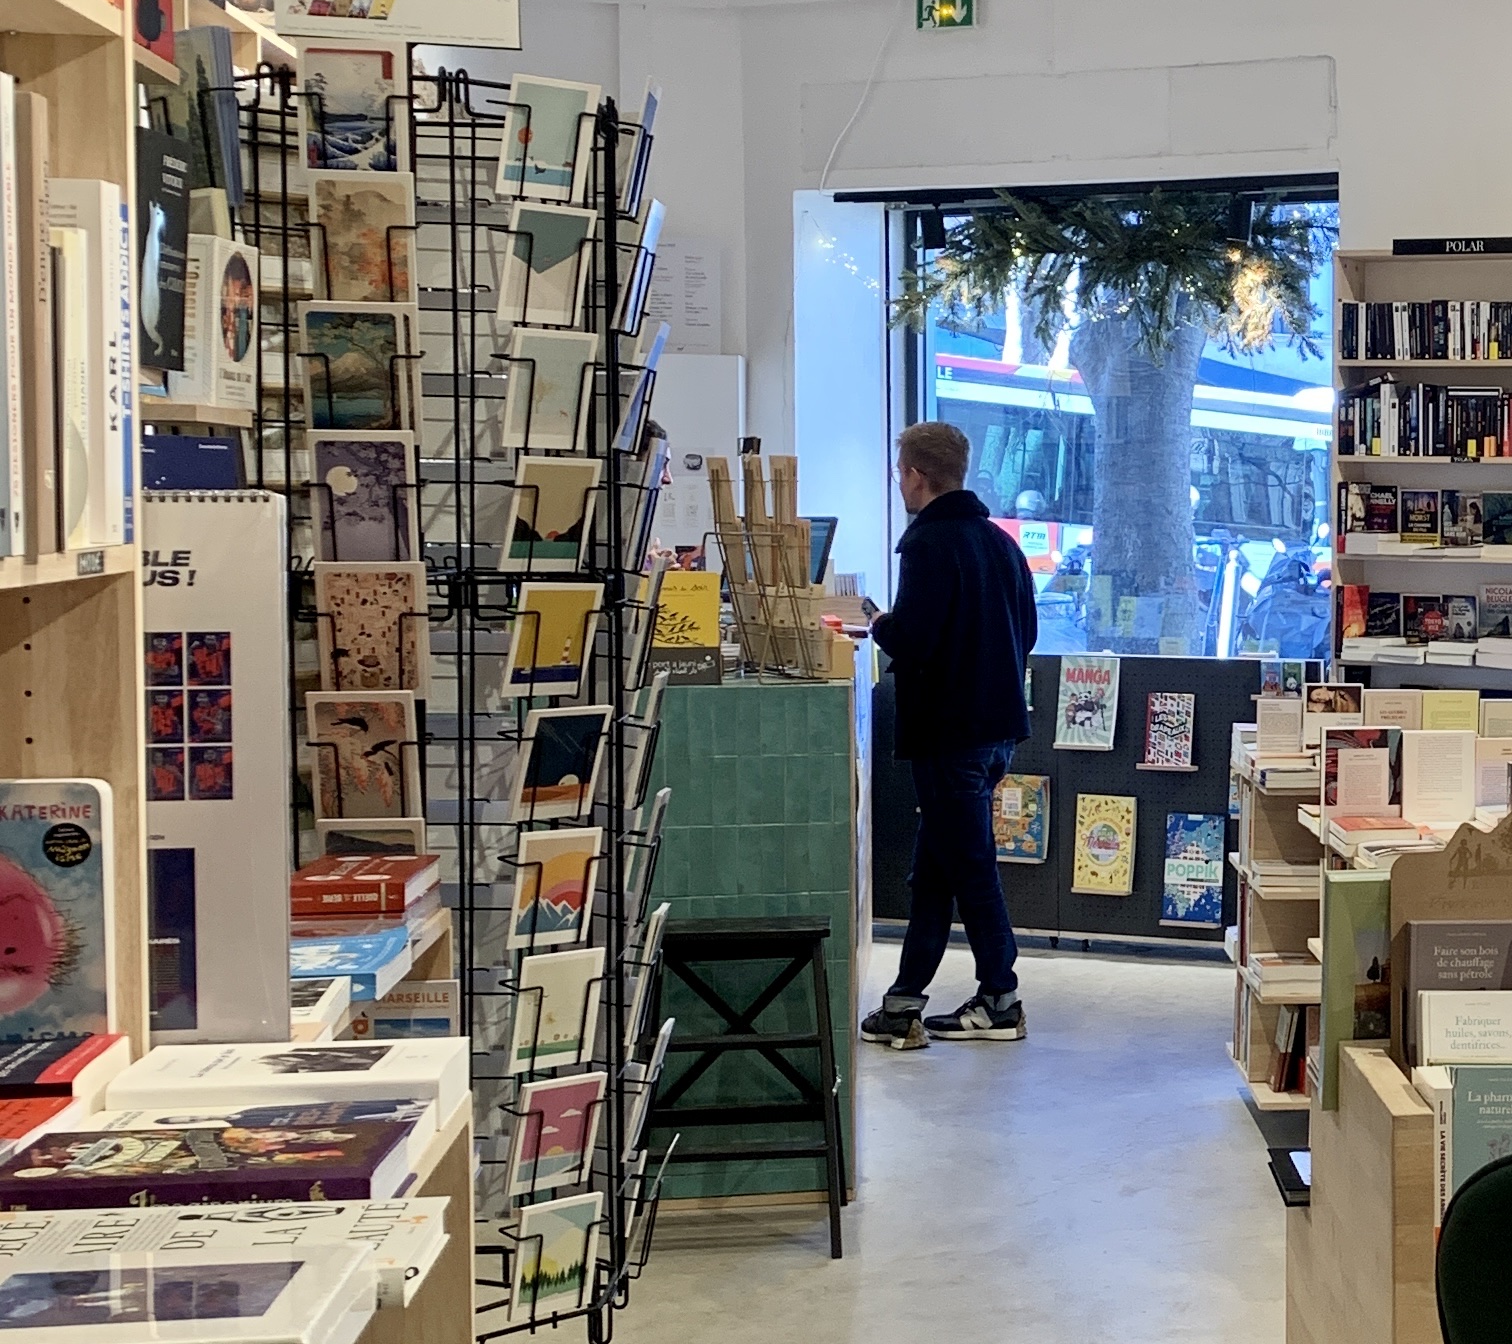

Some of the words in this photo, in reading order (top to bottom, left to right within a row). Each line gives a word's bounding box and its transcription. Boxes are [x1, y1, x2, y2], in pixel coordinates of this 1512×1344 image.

[1446, 240, 1484, 252] POLAR
[936, 365, 953, 380] LE
[109, 331, 118, 432] KARL
[1022, 531, 1046, 540] RTM
[1065, 667, 1111, 685] MANGA
[1433, 946, 1458, 956] Faire
[1459, 948, 1477, 956] son
[1479, 946, 1499, 956] bois
[1436, 957, 1448, 967] de
[1450, 957, 1495, 971] chauffage
[1438, 970, 1458, 980] sans
[1459, 967, 1493, 981] pétrole
[1455, 1015, 1501, 1029] Fabriquer
[1445, 1028, 1477, 1040] huiles,
[1478, 1029, 1512, 1039] savons,
[1467, 1090, 1482, 1102] La
[1440, 1130, 1447, 1140] LA
